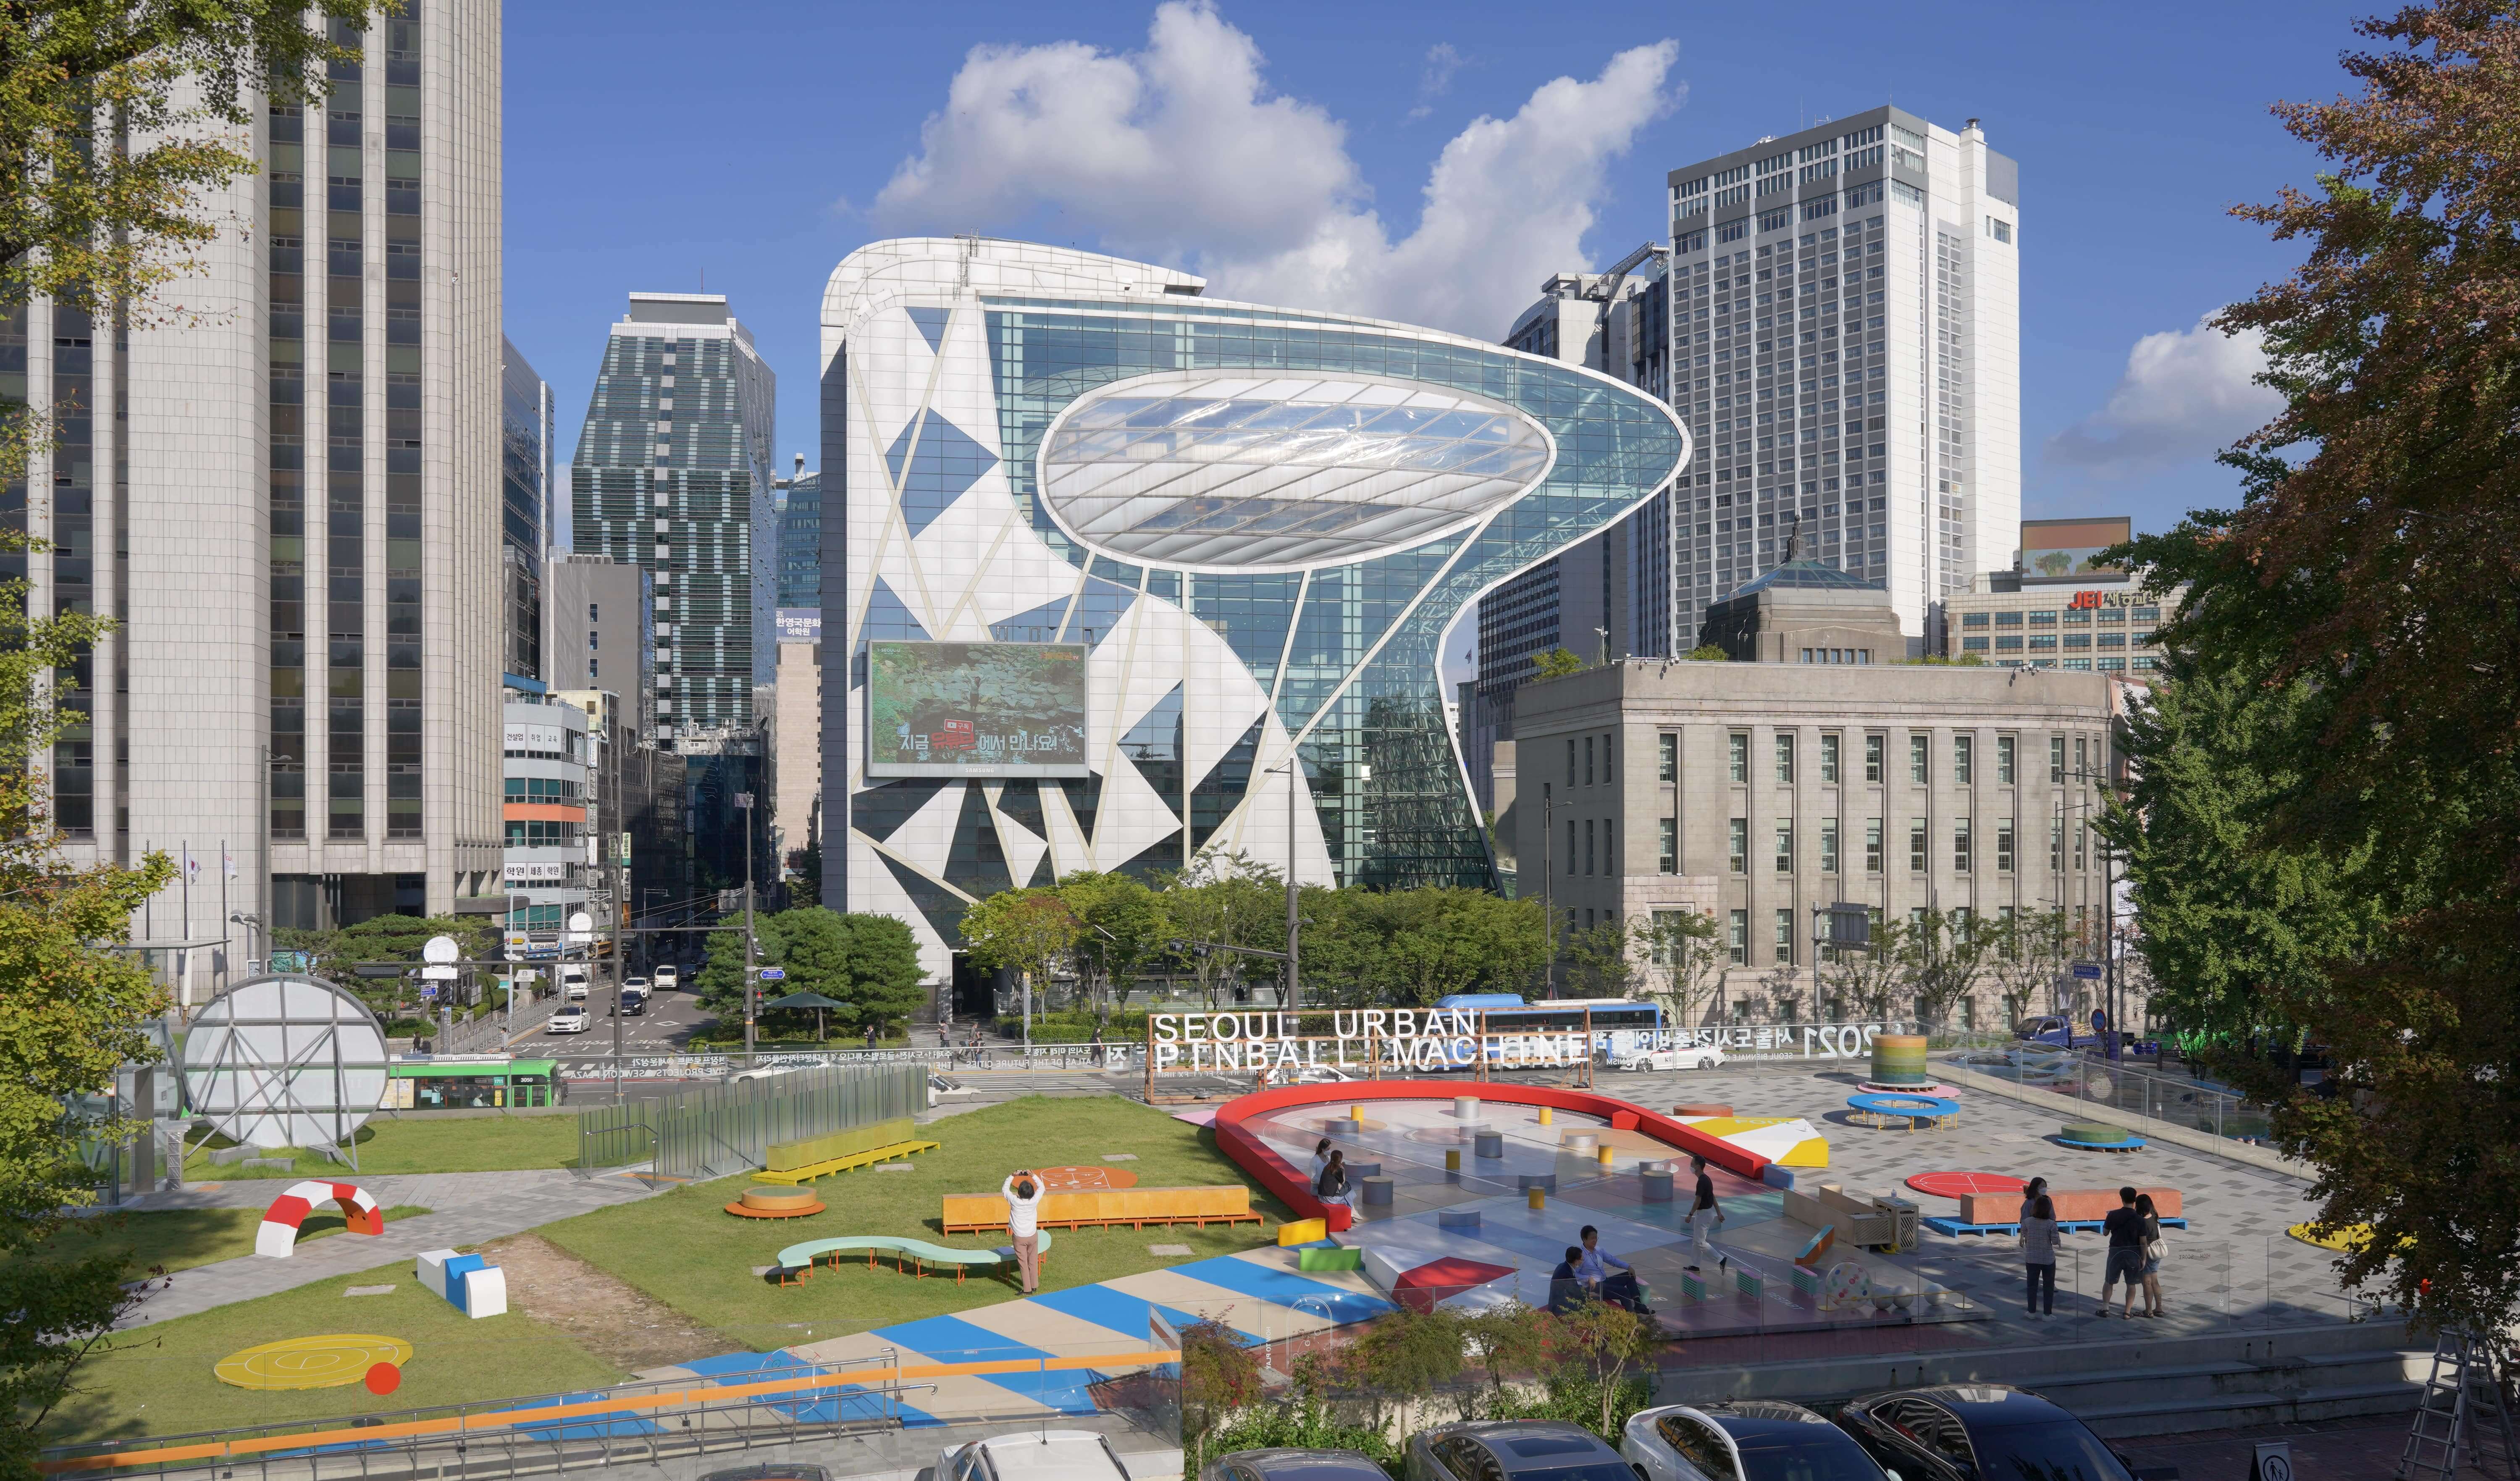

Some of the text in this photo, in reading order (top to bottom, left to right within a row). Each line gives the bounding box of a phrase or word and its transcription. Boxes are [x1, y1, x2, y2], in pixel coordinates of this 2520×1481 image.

[2069, 591, 2102, 608] JEI
[787, 628, 810, 636] 어학원
[957, 722, 969, 730] 구독
[900, 732, 1058, 751] 지금 유튜브 에서 만나요!
[507, 867, 525, 876] 학원
[530, 867, 543, 876] 세종
[547, 866, 559, 875] 학원
[1155, 1008, 1475, 1043] SEOUL URBAN
[1156, 1039, 1357, 1072] PINBALL
[1394, 1034, 1591, 1066] MACHINE
[1765, 1292, 1804, 1310] RESTART
